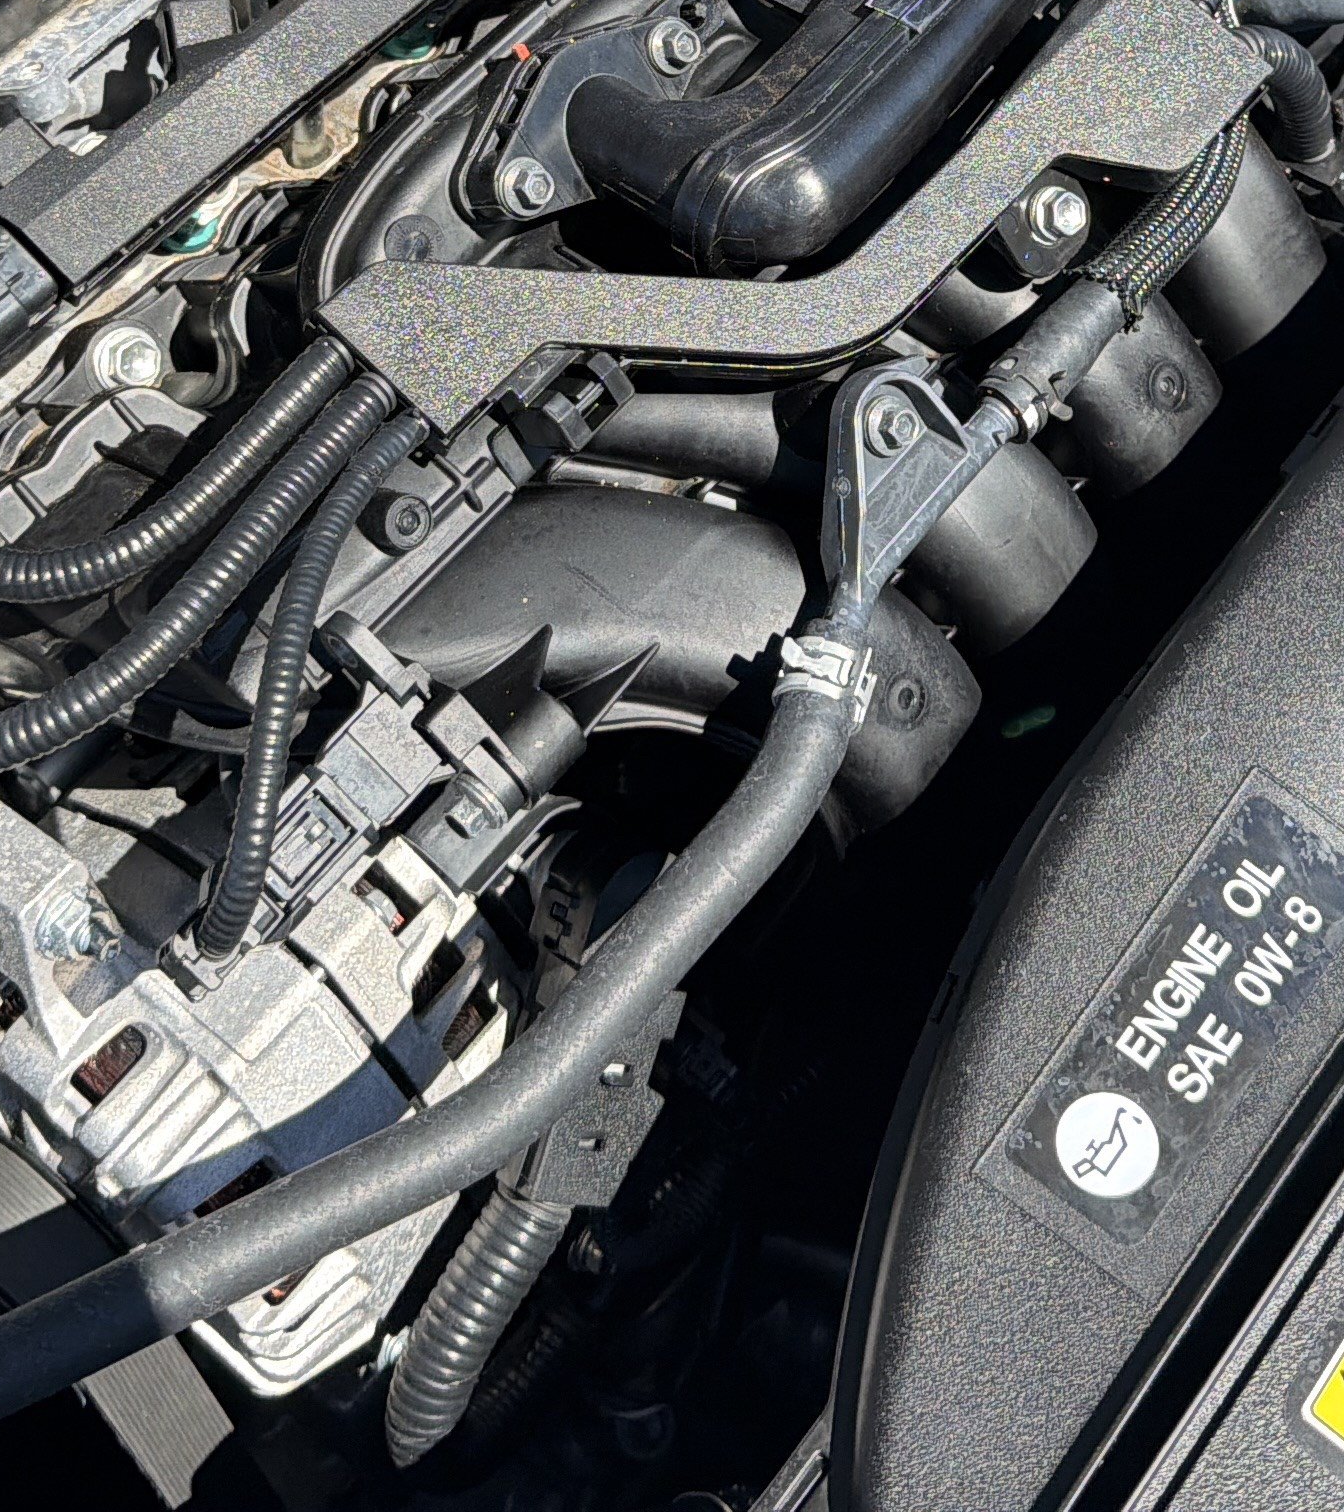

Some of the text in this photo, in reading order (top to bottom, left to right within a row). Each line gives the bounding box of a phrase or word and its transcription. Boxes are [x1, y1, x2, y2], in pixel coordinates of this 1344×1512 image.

[1116, 858, 1286, 1072] ENGINE OIL
[1167, 895, 1323, 1103] SAE 0W-8
